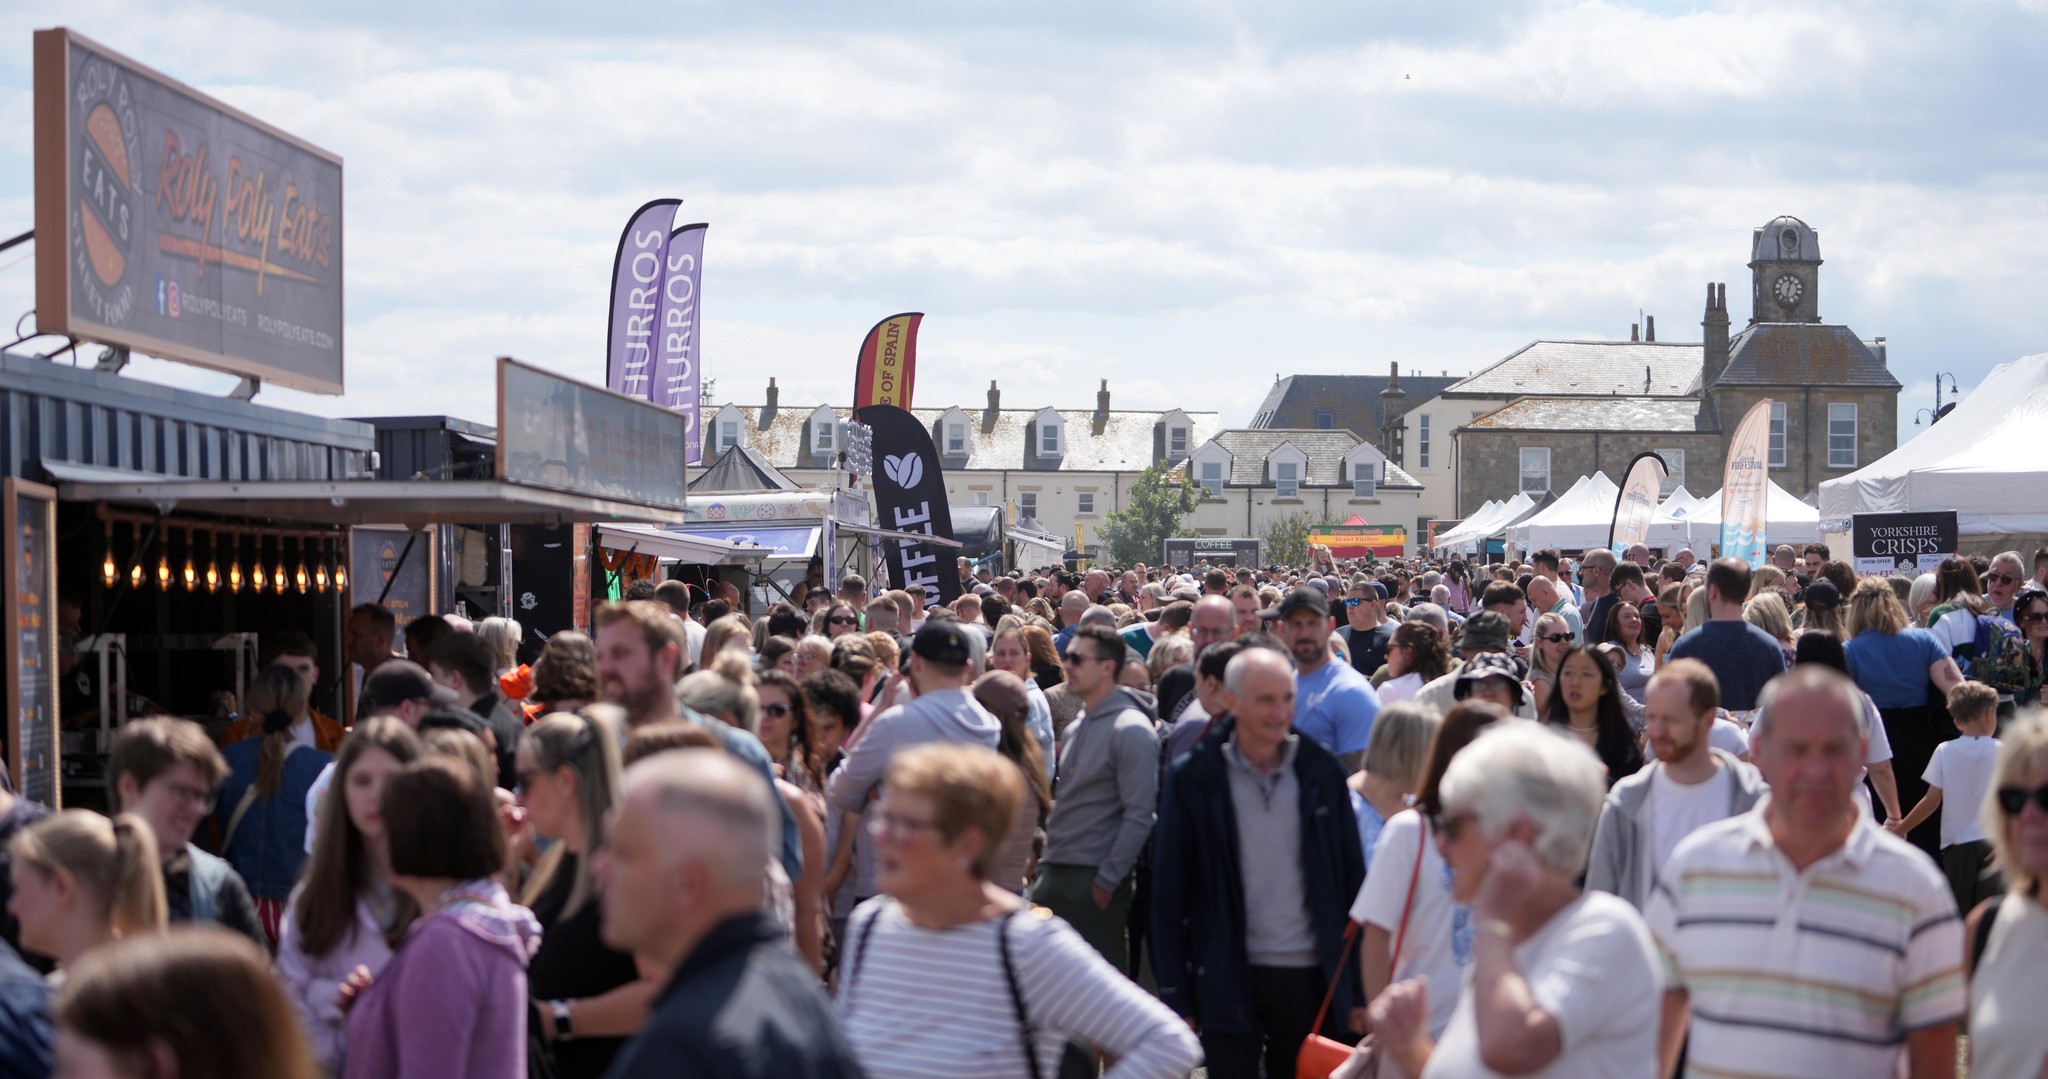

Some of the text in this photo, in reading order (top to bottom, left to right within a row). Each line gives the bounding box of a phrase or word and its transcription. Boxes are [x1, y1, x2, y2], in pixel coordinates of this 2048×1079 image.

[83, 147, 129, 240] EATS
[155, 130, 331, 296] Roly Poly Eats
[182, 292, 248, 326] ROLYPOLYEATS
[624, 230, 664, 401] HURROS
[884, 322, 900, 366] SPAIN
[881, 371, 894, 392] OF
[1870, 525, 1938, 538] YORKSHIRE
[1871, 537, 1938, 555] CRISPS
